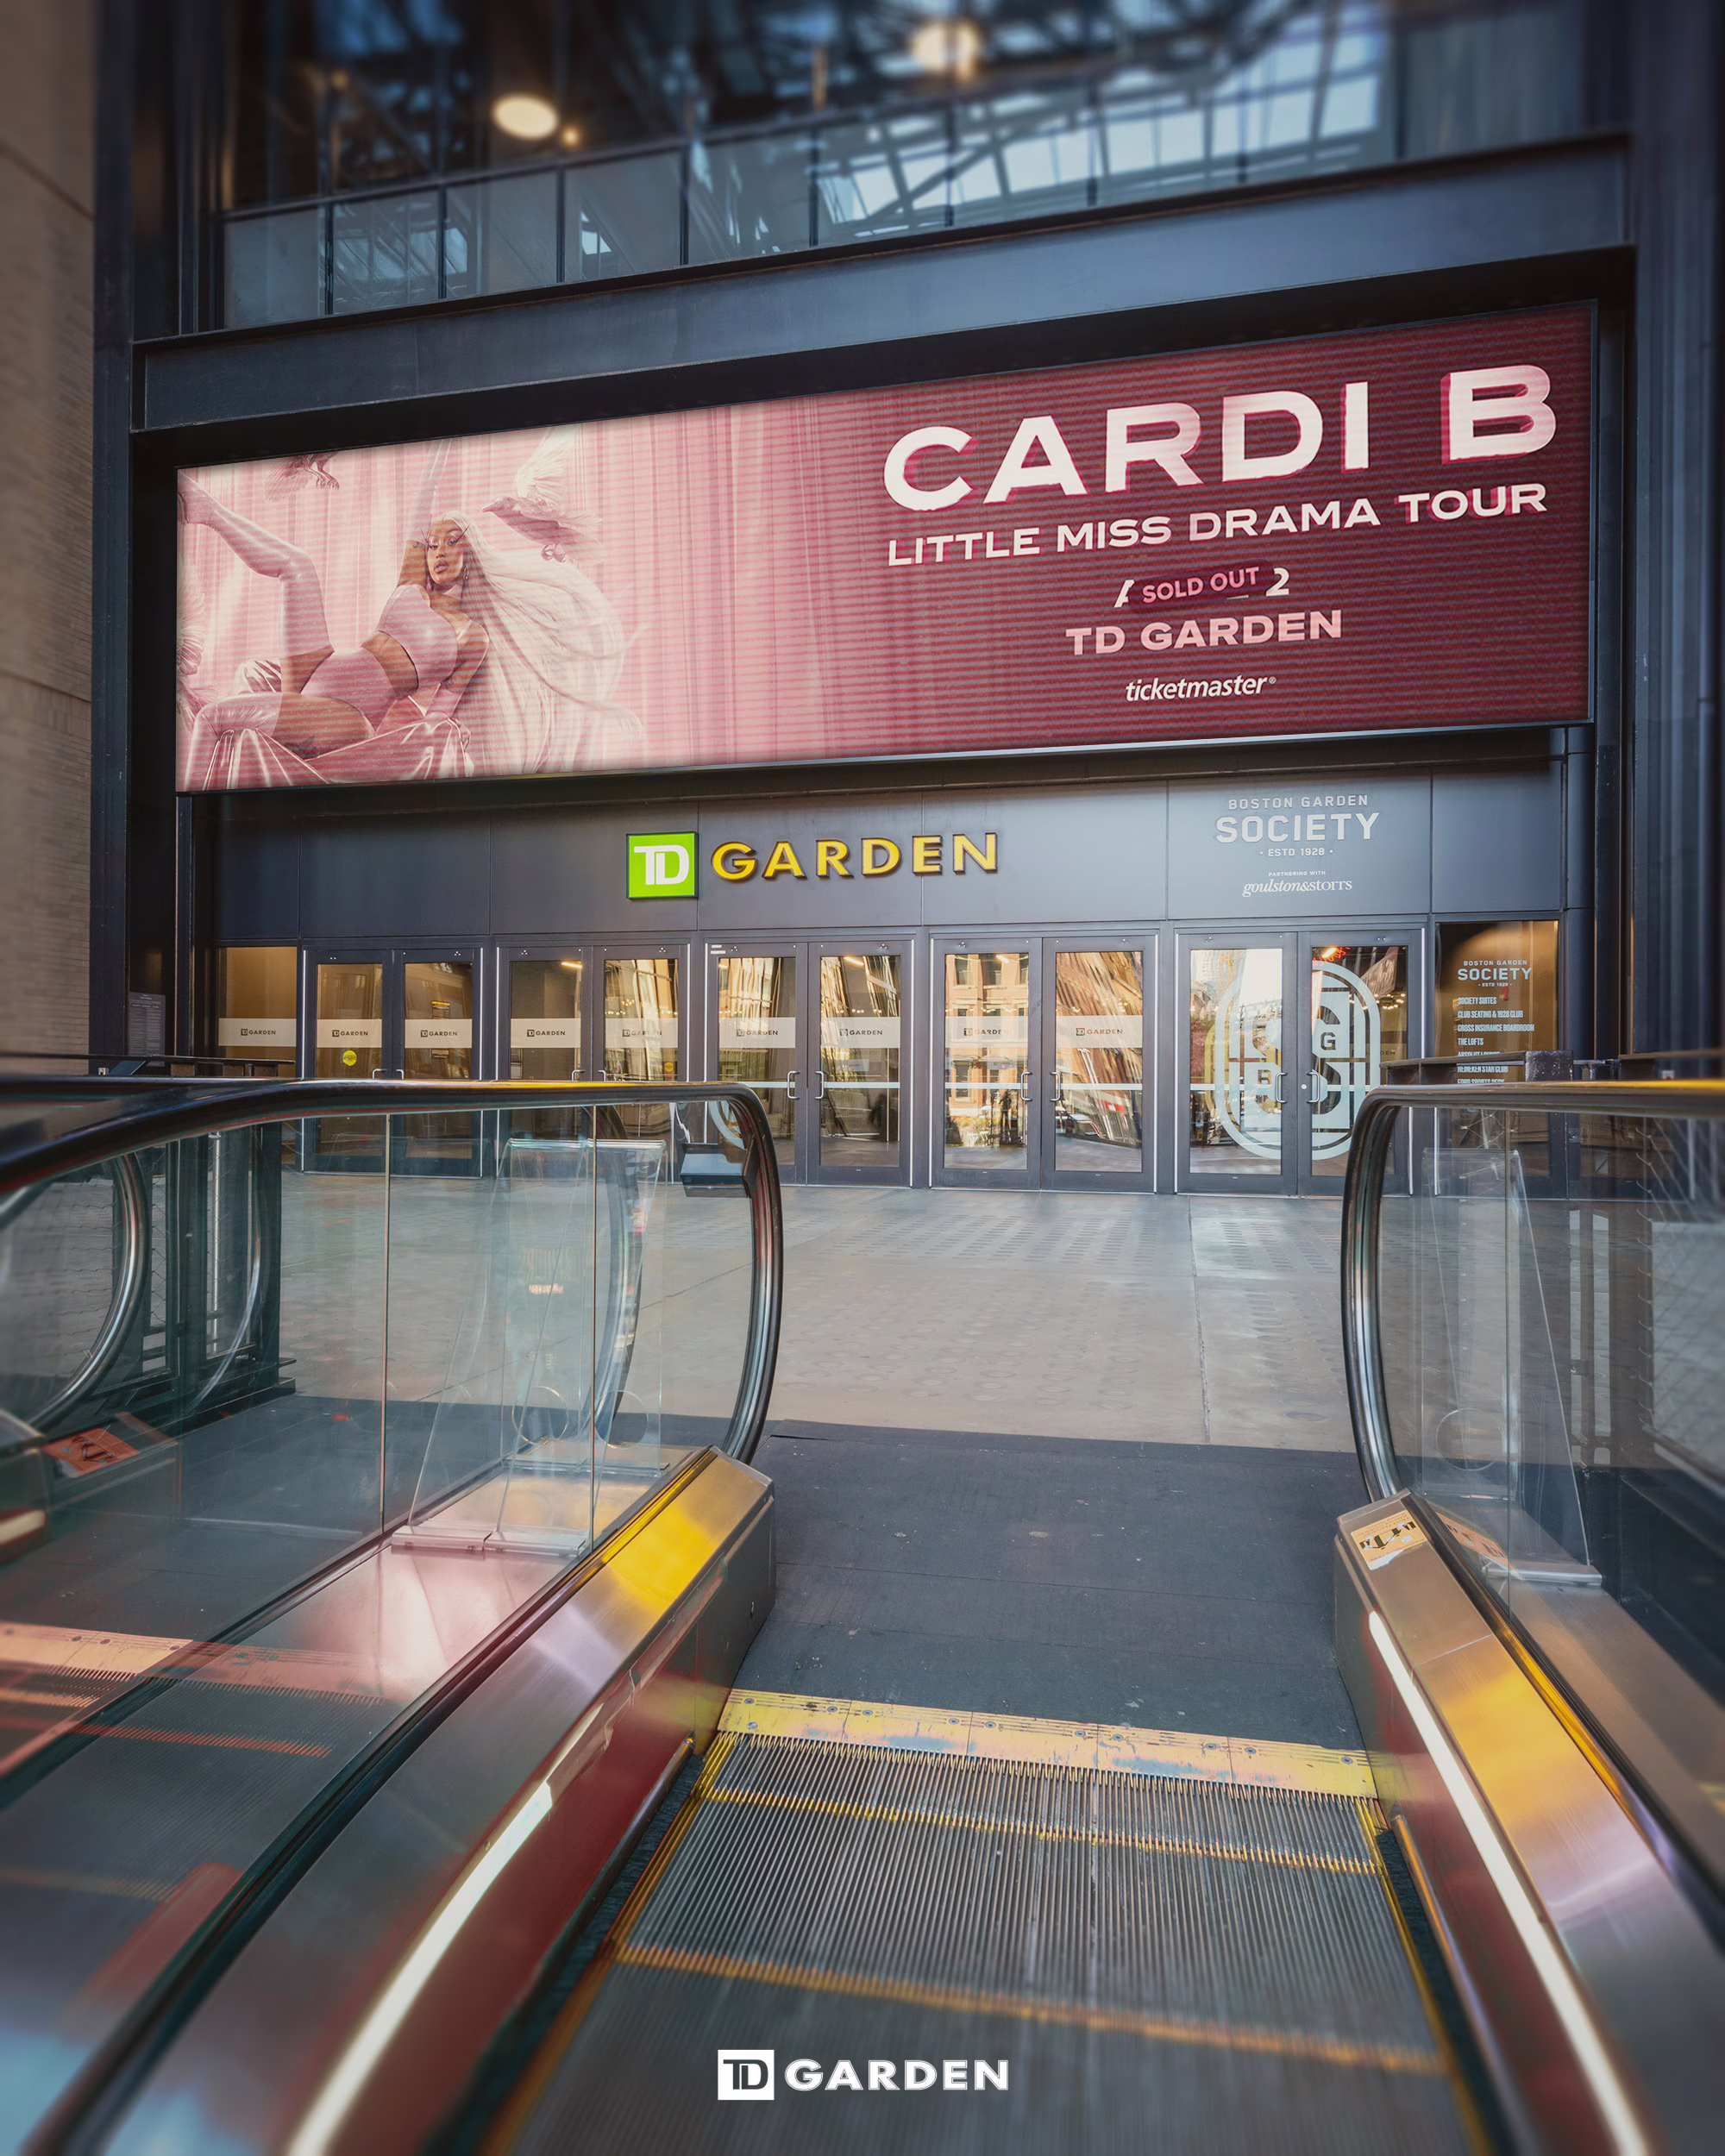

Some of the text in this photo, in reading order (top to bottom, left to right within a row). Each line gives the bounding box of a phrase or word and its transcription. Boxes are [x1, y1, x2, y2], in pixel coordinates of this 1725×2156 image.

[882, 365, 1556, 512] CARDI B
[888, 483, 1547, 567] LITTLE MISS DRAMA TOUR
[1142, 577, 1204, 604] SOLD
[1210, 567, 1259, 592] OUT
[1265, 567, 1290, 597] 2
[1065, 610, 1343, 655] TD GARDEN
[1228, 794, 1369, 810] BOSTON GARDEN
[1215, 812, 1380, 843] SOCIETY
[631, 832, 997, 888] TD GARDEN
[1268, 847, 1326, 856] ESTD 1928
[1242, 878, 1352, 898] goulston&storrs
[1457, 968, 1533, 981] SOCIETY
